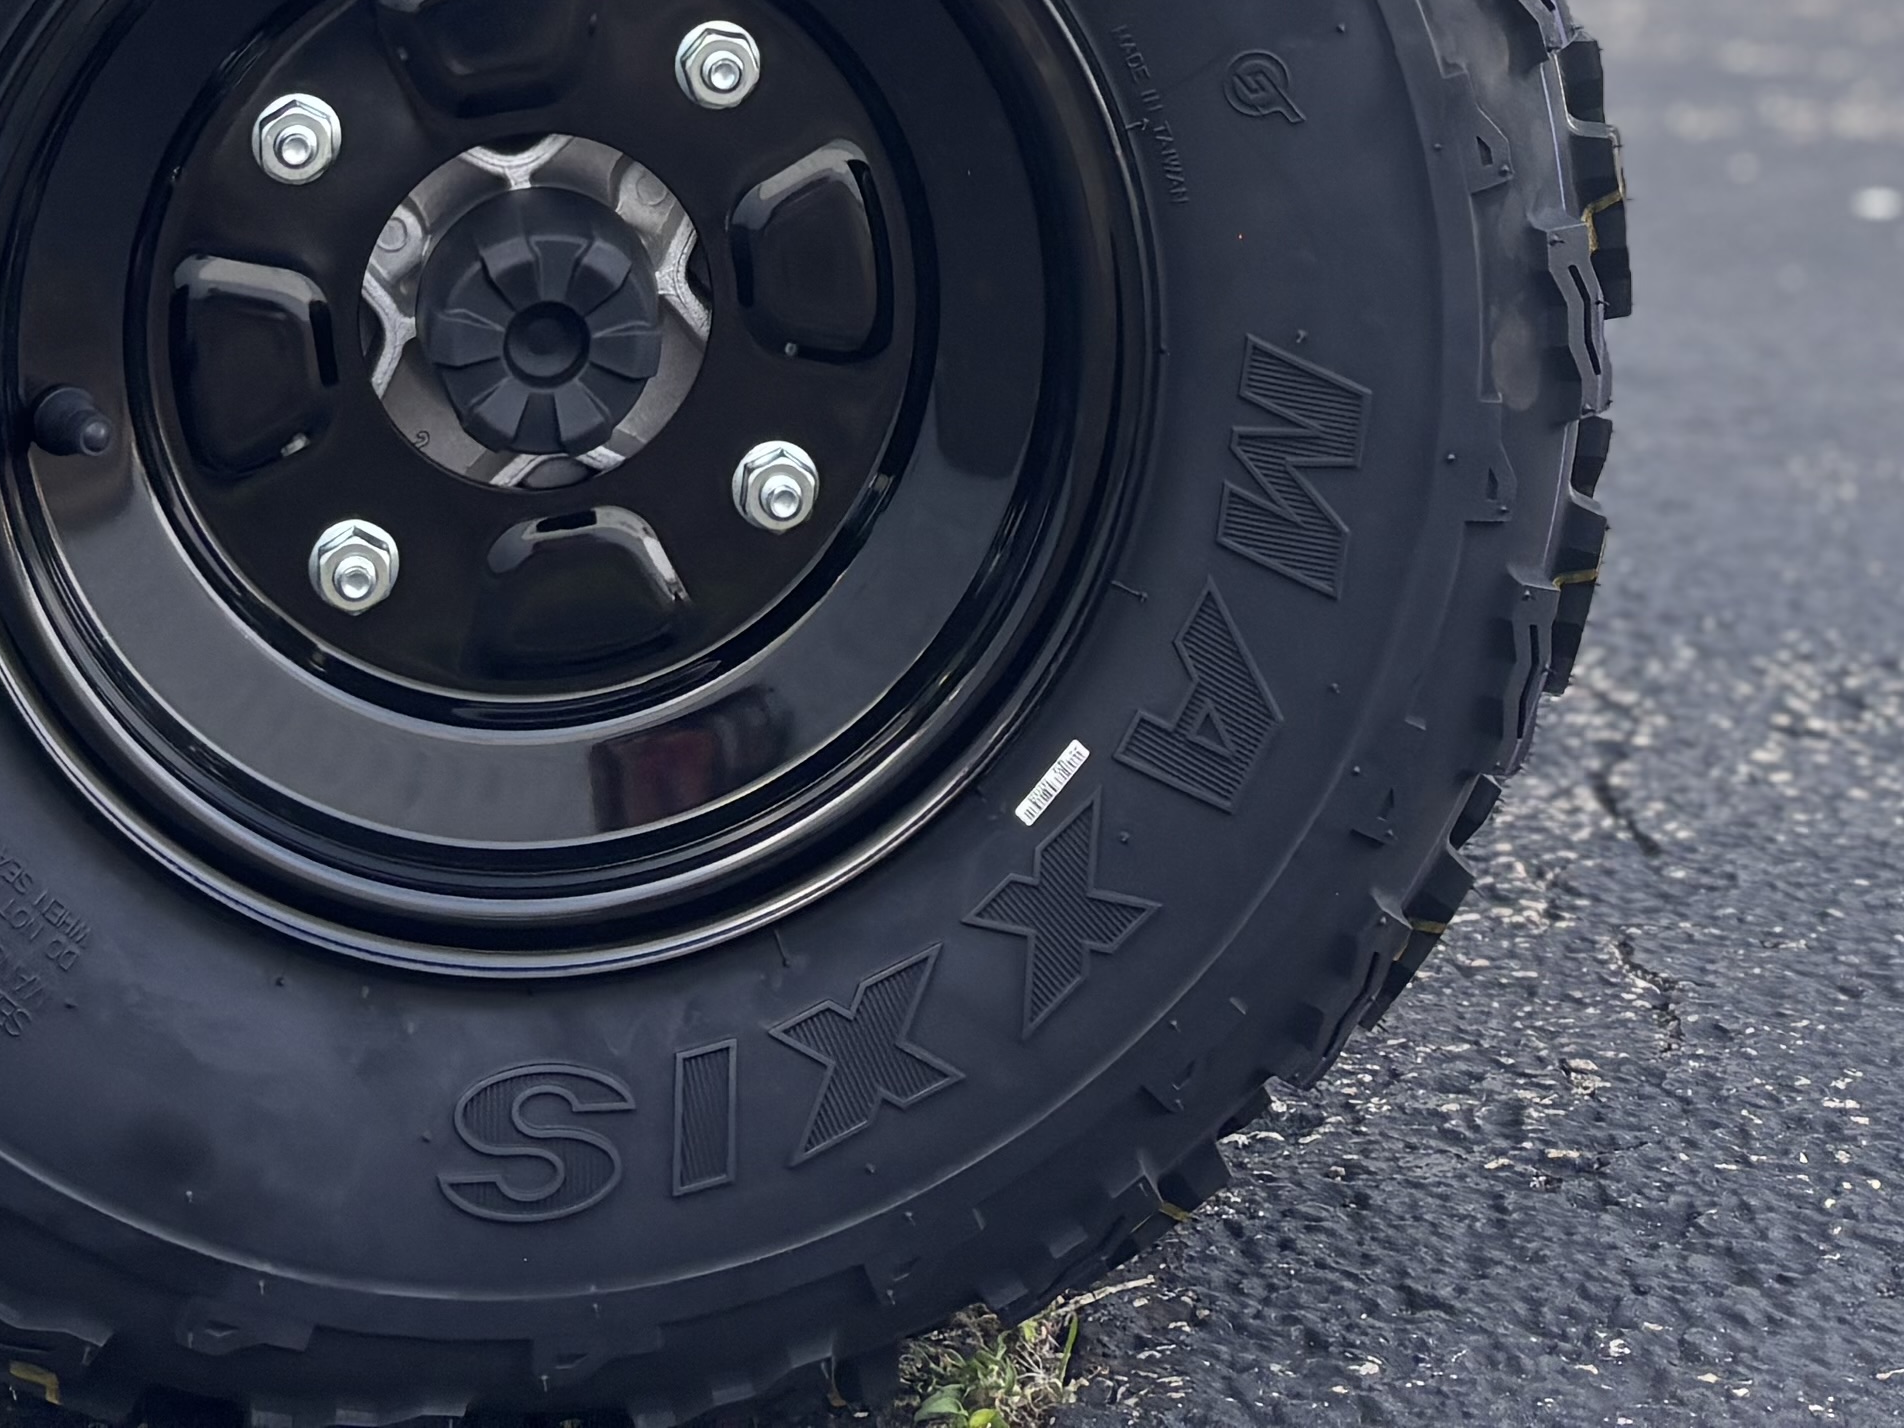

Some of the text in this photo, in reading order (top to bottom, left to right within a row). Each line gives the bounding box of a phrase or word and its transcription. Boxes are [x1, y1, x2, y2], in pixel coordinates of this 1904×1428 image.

[1112, 25, 1190, 205] MADE IN TAIWAN
[438, 333, 1372, 1223] MAXXIS
[32, 890, 91, 942] WHEN
[45, 938, 78, 972] DO
